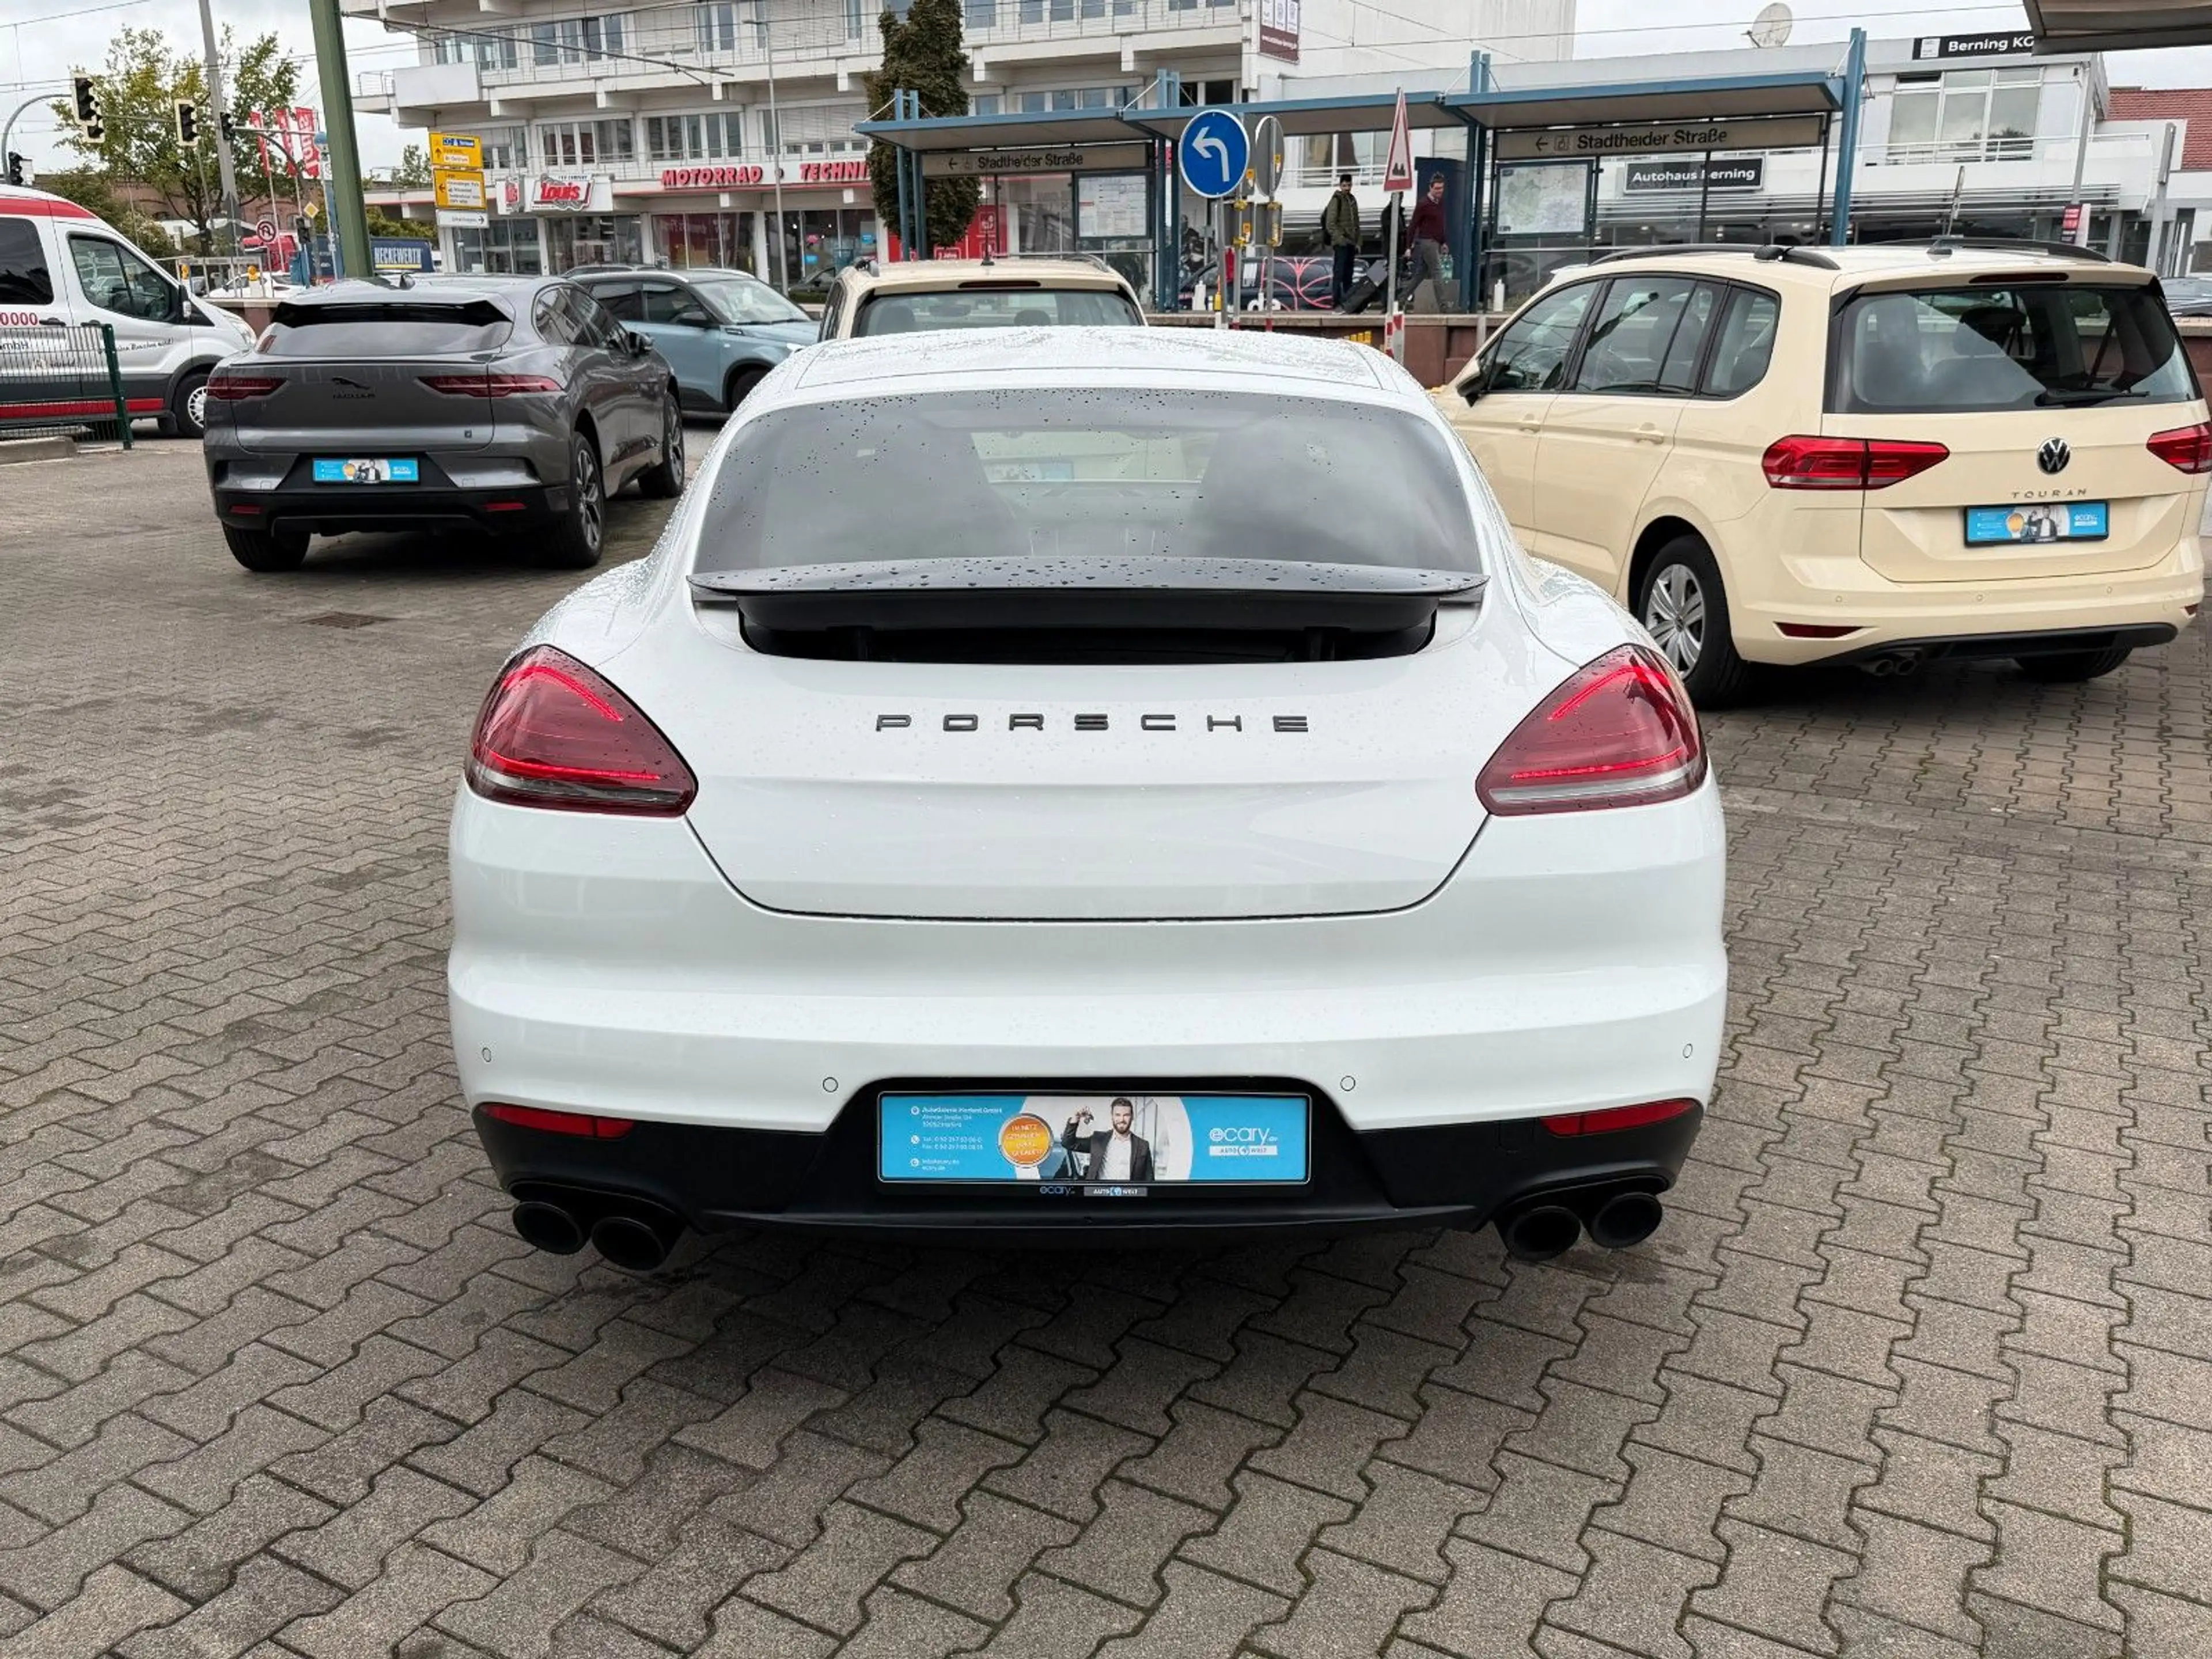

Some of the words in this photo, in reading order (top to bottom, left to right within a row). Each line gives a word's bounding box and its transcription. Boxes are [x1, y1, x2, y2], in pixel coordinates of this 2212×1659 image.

[1948, 39, 2008, 52] Berning
[2013, 36, 2035, 48] KG
[1577, 131, 1669, 149] Stadtheider
[1673, 127, 1728, 145] Straße
[1045, 152, 1084, 166] Straße
[662, 165, 763, 187] MOTORRAD
[800, 161, 870, 181] TECHNI
[1631, 170, 1698, 183] Autohaus
[540, 181, 580, 200] Louis
[2010, 488, 2087, 499] TOURAN
[876, 714, 1308, 732] PORSCHE
